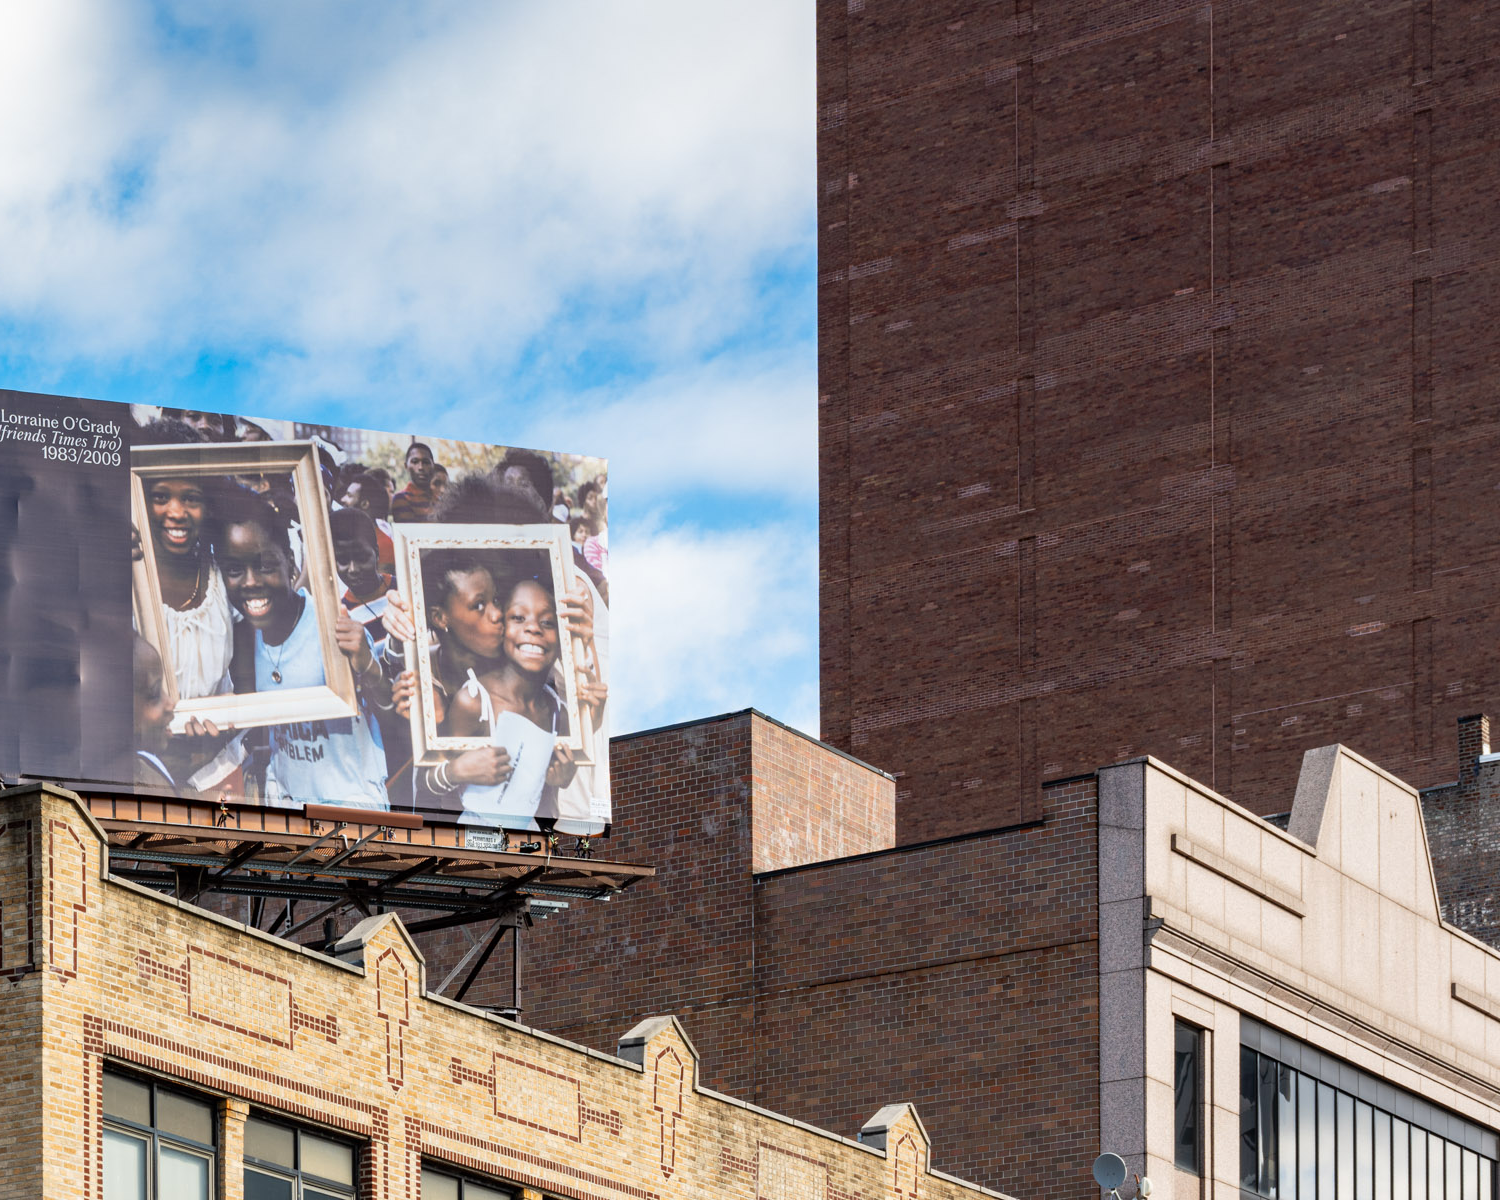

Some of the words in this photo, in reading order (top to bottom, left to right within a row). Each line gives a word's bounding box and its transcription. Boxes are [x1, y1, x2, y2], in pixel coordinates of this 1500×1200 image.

[1, 409, 59, 429] Lorraine
[63, 416, 121, 439] O'Grady
[51, 430, 88, 448] Times
[93, 435, 123, 453] Two)
[41, 446, 121, 467] 1983/2009
